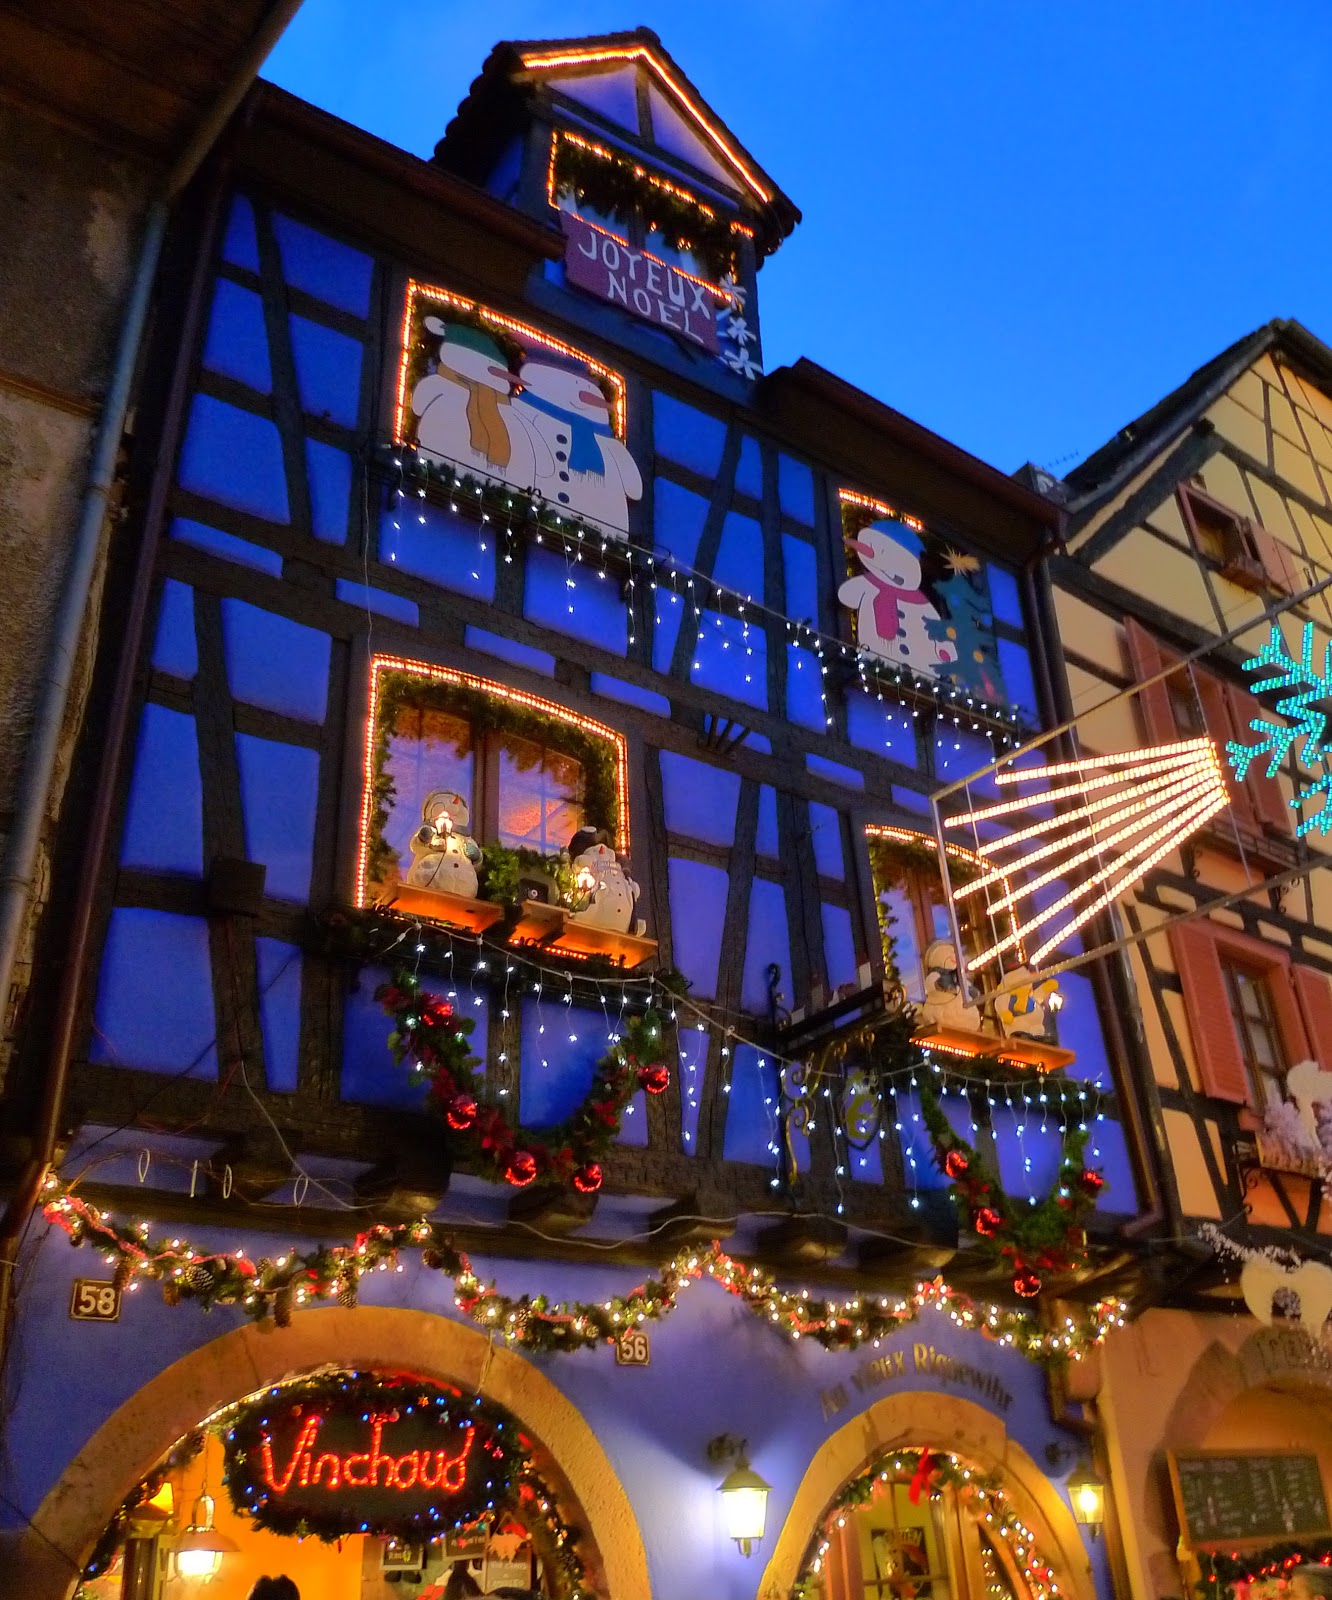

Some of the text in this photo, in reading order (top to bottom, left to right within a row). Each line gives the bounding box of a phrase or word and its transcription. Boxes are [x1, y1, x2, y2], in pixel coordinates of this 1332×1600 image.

[578, 231, 711, 321] JOYEUX
[607, 271, 704, 344] NOEL
[79, 1285, 116, 1315] 58
[622, 1335, 647, 1361] 56
